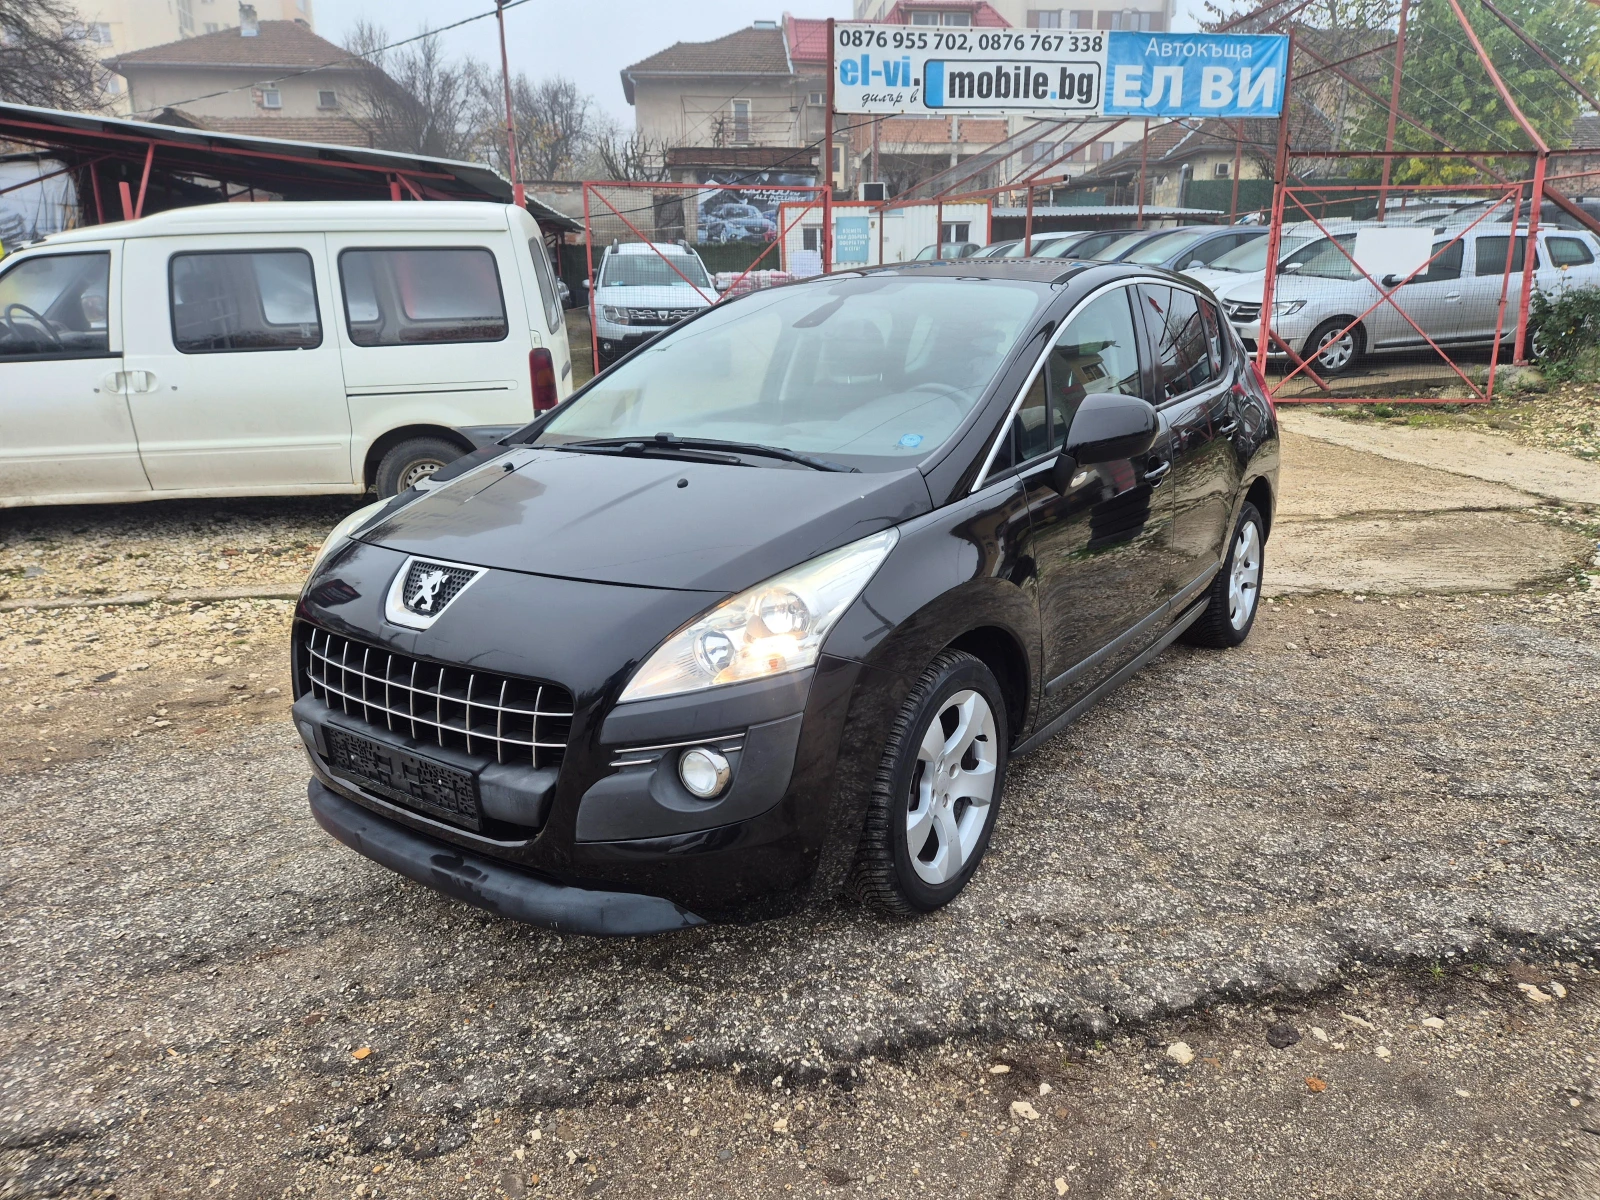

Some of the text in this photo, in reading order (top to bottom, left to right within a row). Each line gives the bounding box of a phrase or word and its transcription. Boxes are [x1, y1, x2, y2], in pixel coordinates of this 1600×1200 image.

[839, 30, 1103, 53] 0876 955 702, 0876 767 338
[1144, 37, 1253, 60] Автокъща
[949, 65, 1094, 104] mobile.bg
[1112, 64, 1277, 109] ЕЛ ВИ
[861, 90, 903, 110] дилър
